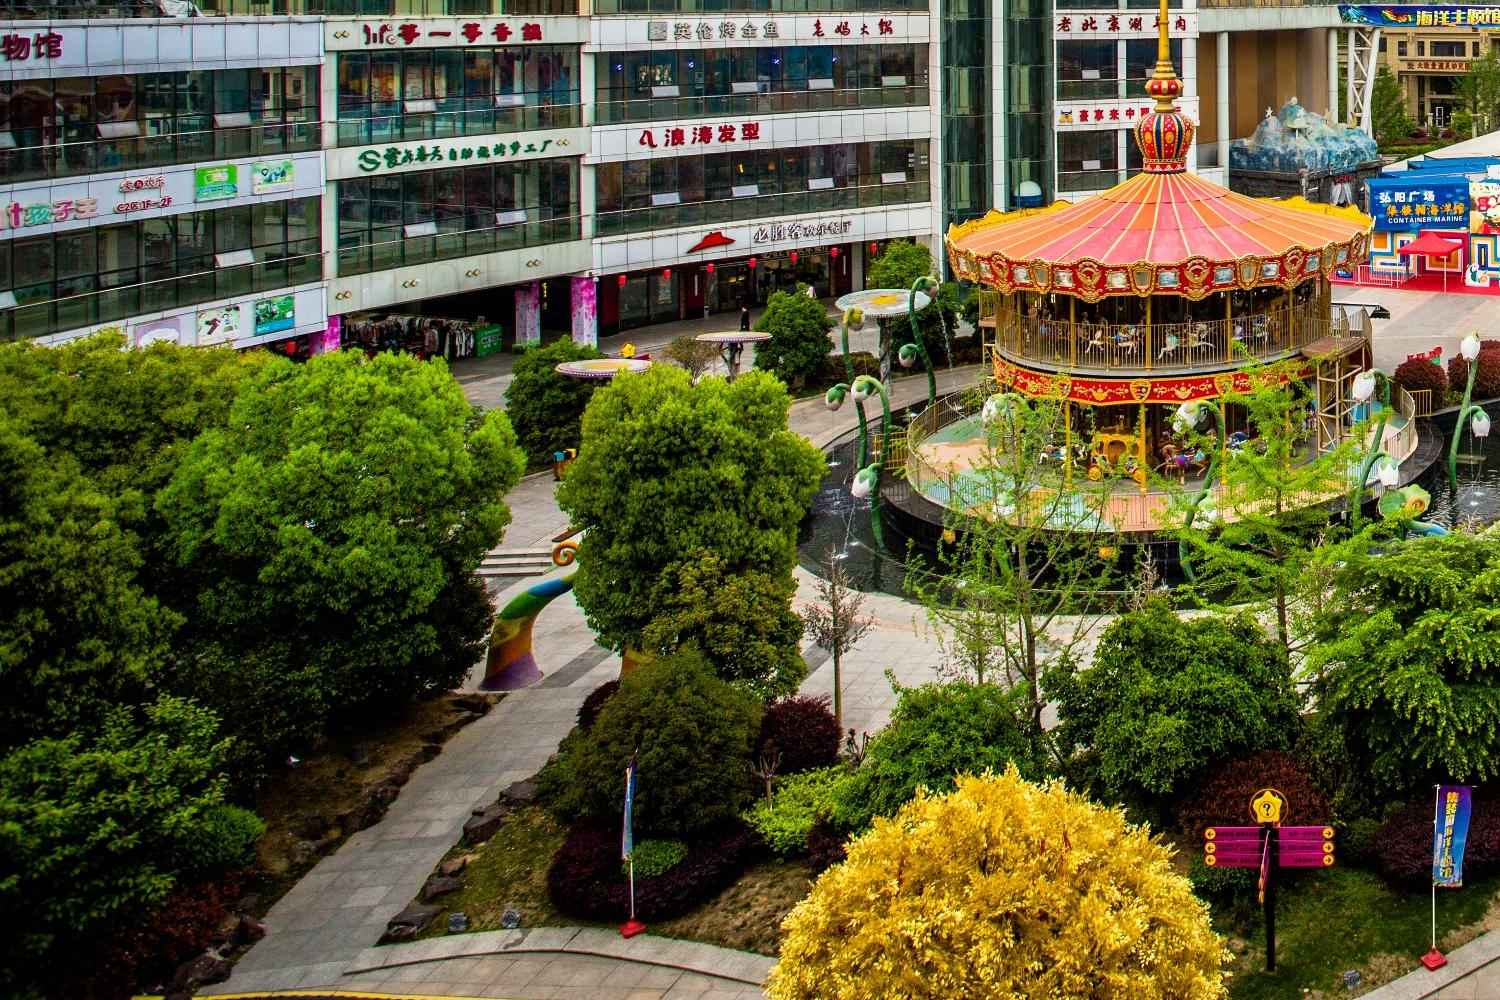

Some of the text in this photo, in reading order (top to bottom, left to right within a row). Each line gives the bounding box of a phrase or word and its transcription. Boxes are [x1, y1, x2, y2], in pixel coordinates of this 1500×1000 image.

[663, 122, 760, 147] 浪涛发型
[1379, 190, 1435, 204] 弘阳广场
[1386, 203, 1465, 216] 集装箱海洋馆
[1388, 215, 1463, 224] CONTAINER MARINE
[753, 220, 852, 244] 必胜客欢乐餐厅
